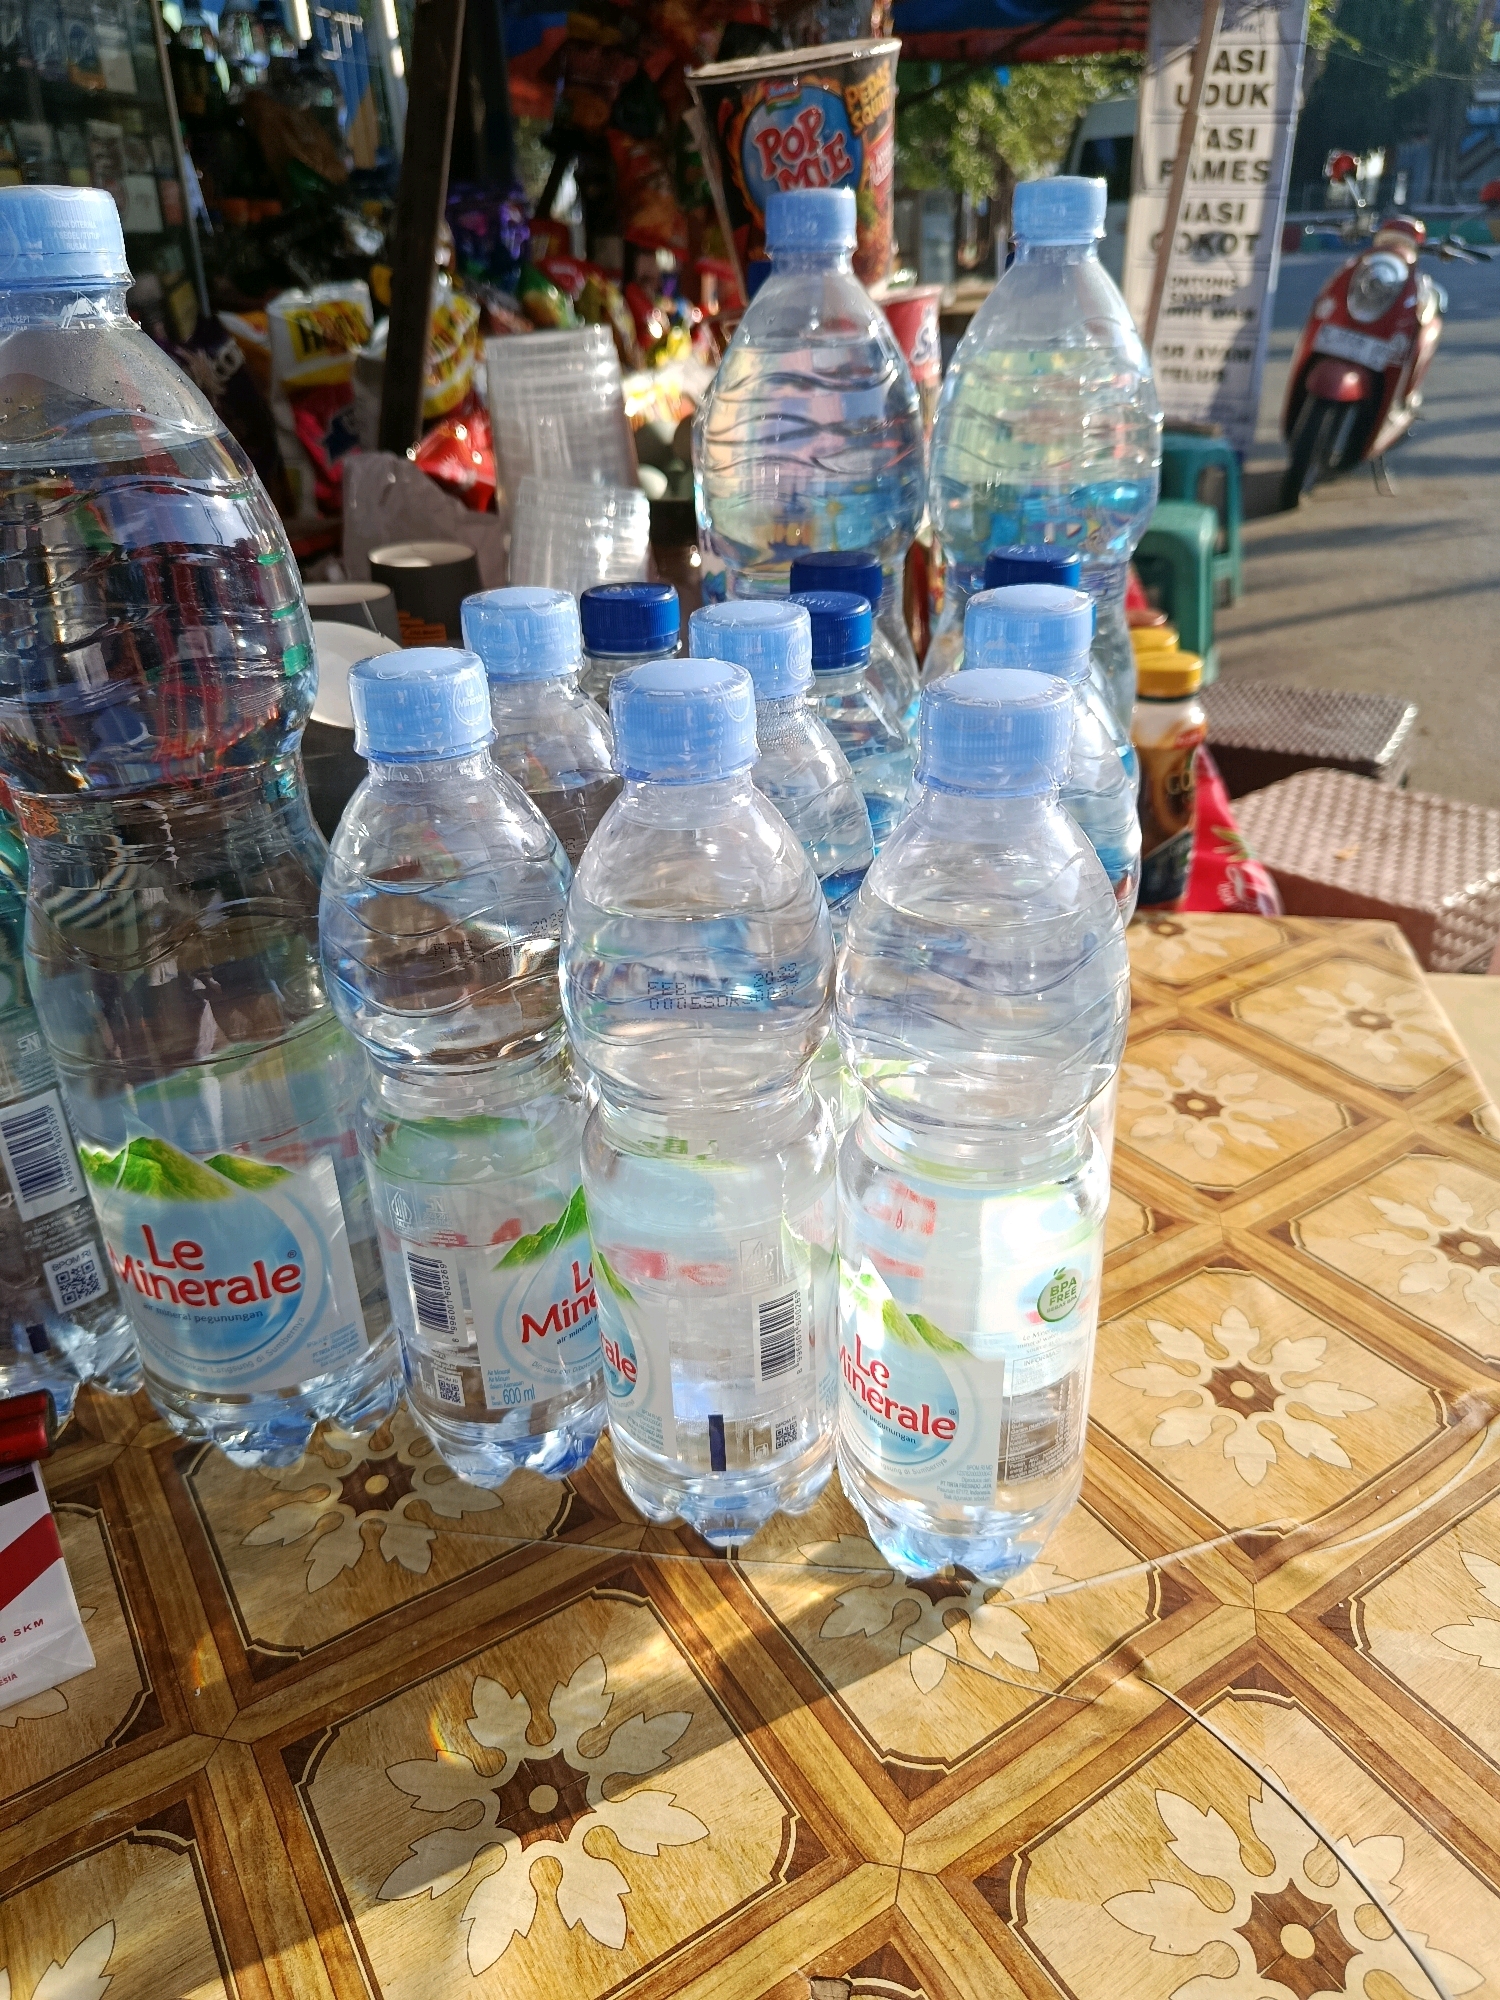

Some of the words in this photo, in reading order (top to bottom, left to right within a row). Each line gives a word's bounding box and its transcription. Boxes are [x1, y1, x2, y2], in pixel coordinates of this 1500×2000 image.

[1190, 49, 1268, 74] ASI
[754, 107, 822, 181] POP
[1205, 127, 1257, 151] ASI
[776, 132, 853, 192] MIE
[647, 981, 687, 996] FEB
[141, 1224, 205, 1271] Le
[107, 1239, 302, 1307] Minerale
[572, 1260, 593, 1295] L
[1049, 1276, 1077, 1297] BPA
[1049, 1285, 1077, 1307] FREE
[194, 1309, 264, 1324] pegunungan
[211, 1355, 254, 1374] Langsung
[256, 1355, 266, 1363] di
[265, 1316, 305, 1357] Sumbernya
[855, 1333, 890, 1389] Le
[502, 1386, 522, 1405] 600
[523, 1383, 536, 1402] ml
[13, 1618, 45, 1637] SKM
